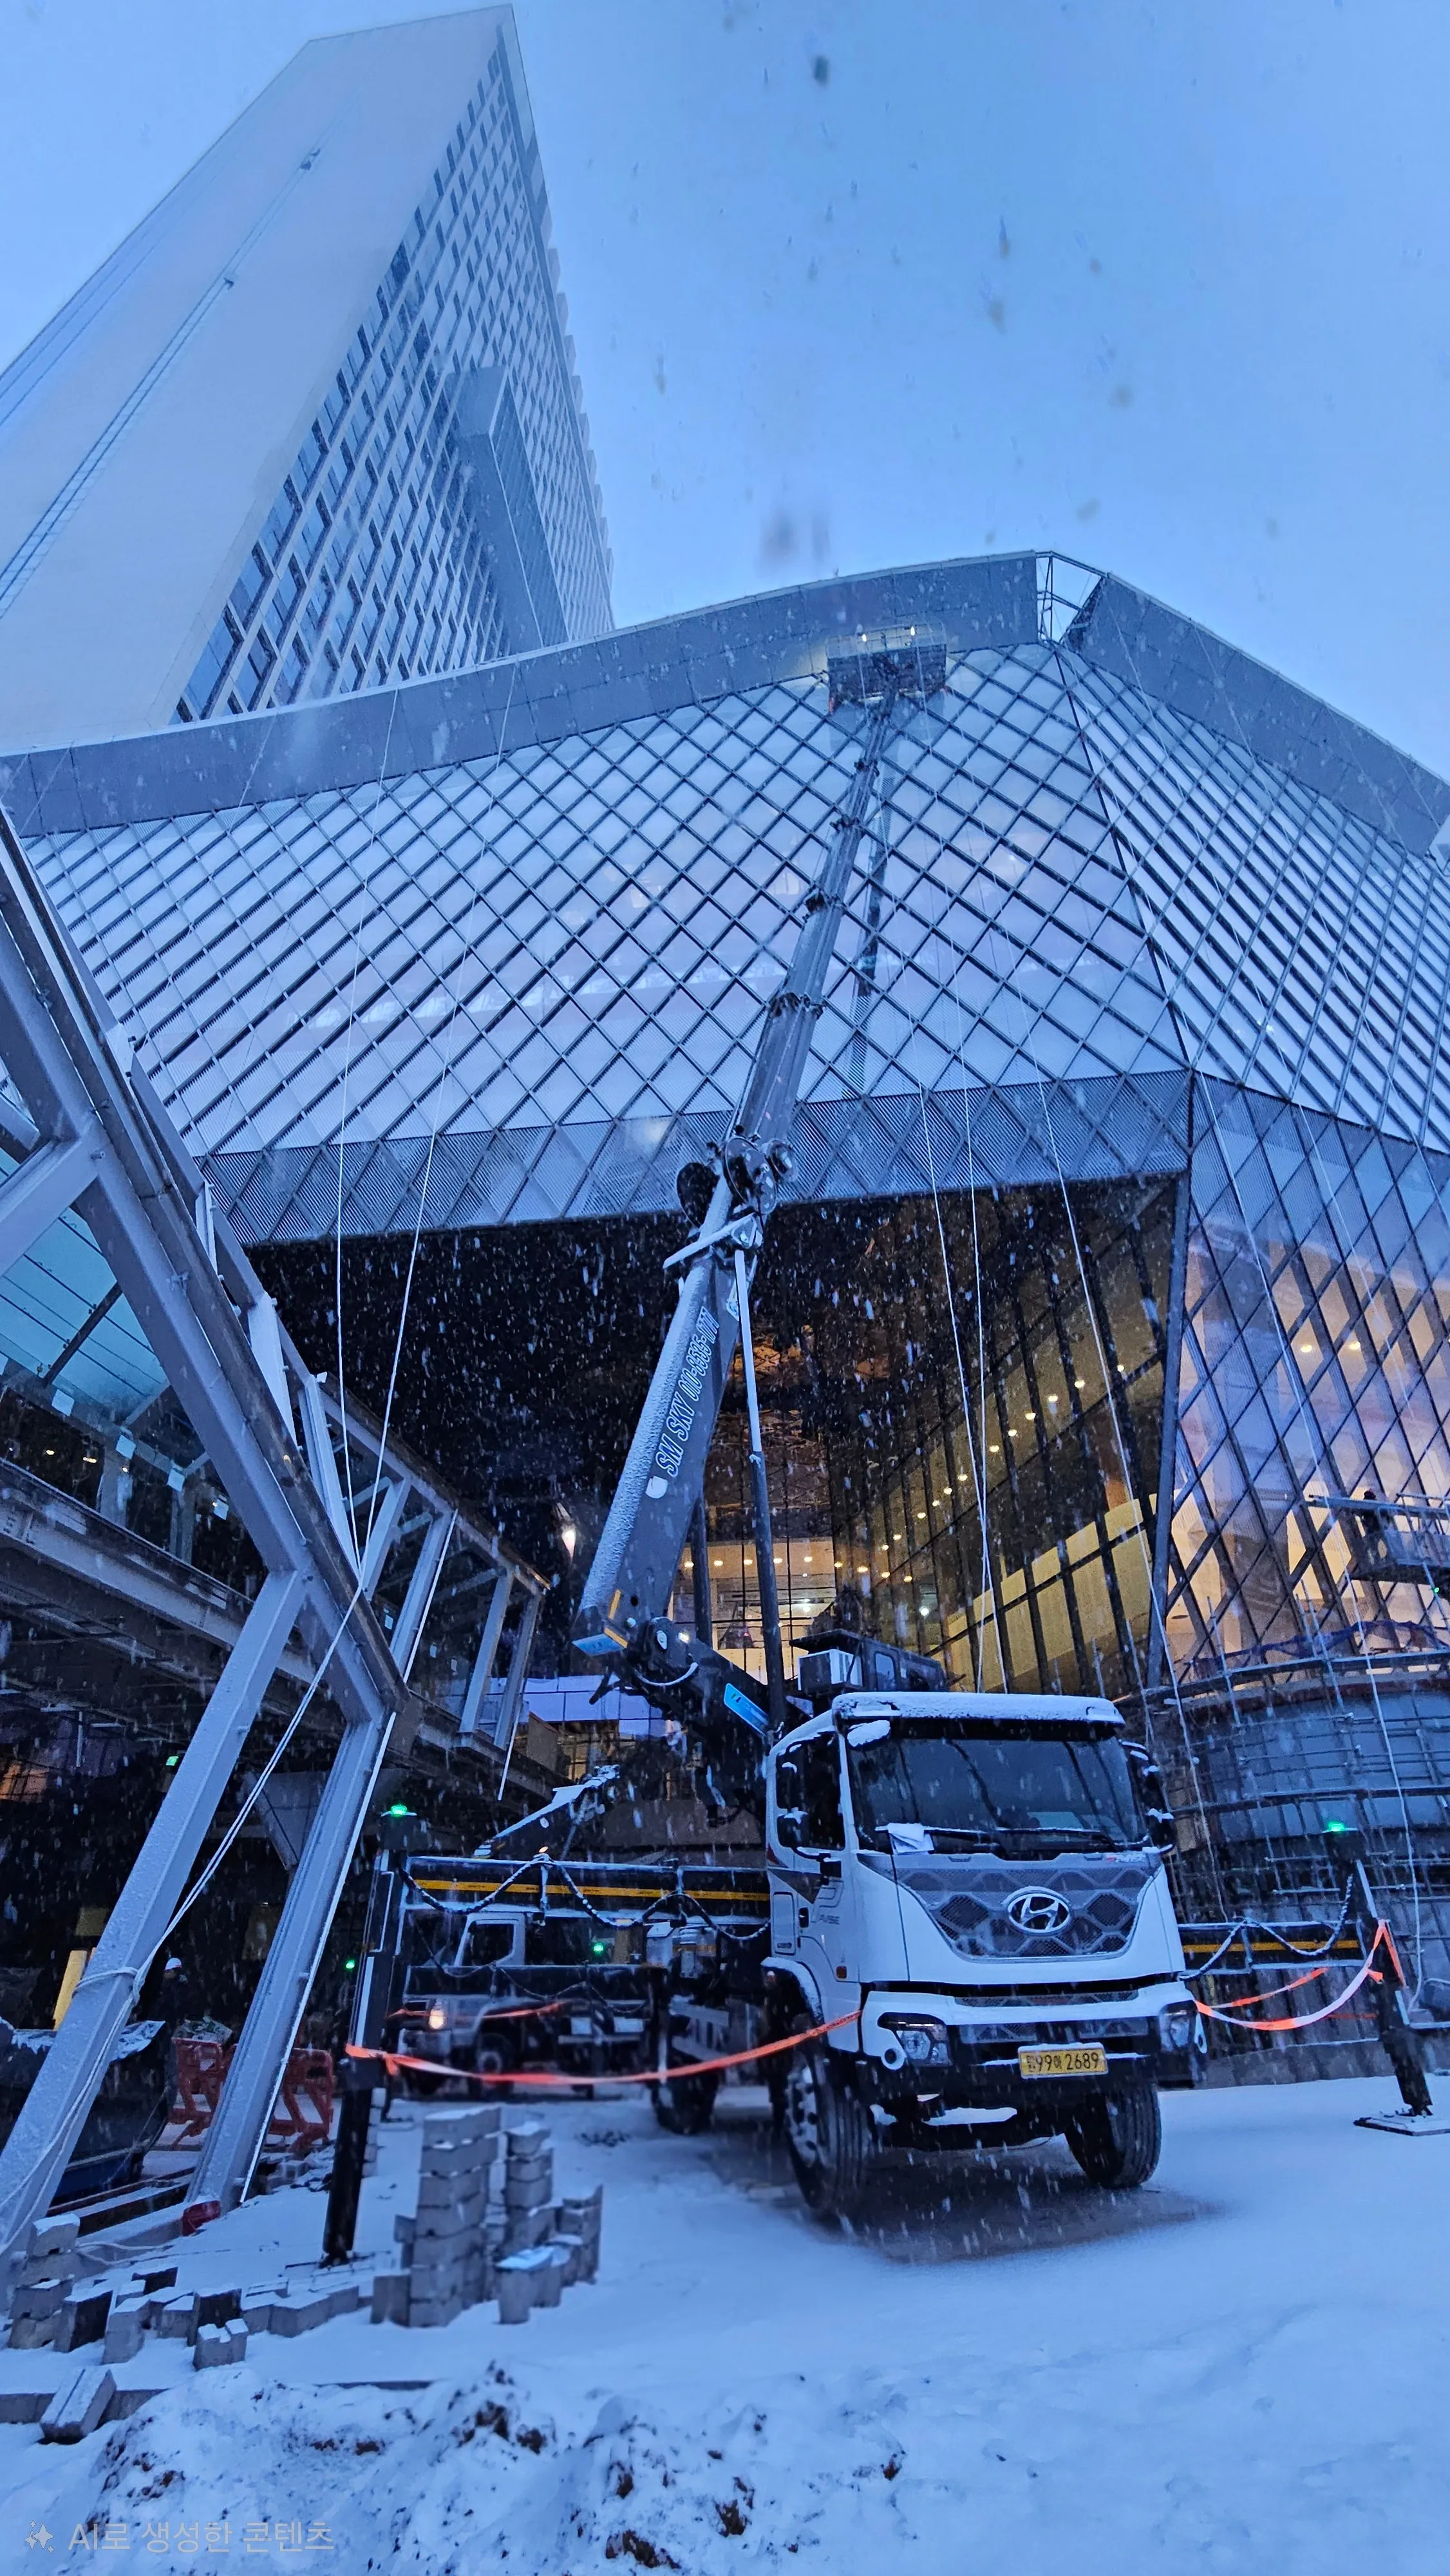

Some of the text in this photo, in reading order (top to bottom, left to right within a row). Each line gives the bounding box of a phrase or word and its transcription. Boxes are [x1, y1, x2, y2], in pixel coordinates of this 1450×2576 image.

[666, 1391, 695, 1441] SKY
[655, 1433, 684, 1477] SM
[1065, 2052, 1098, 2070] 2689
